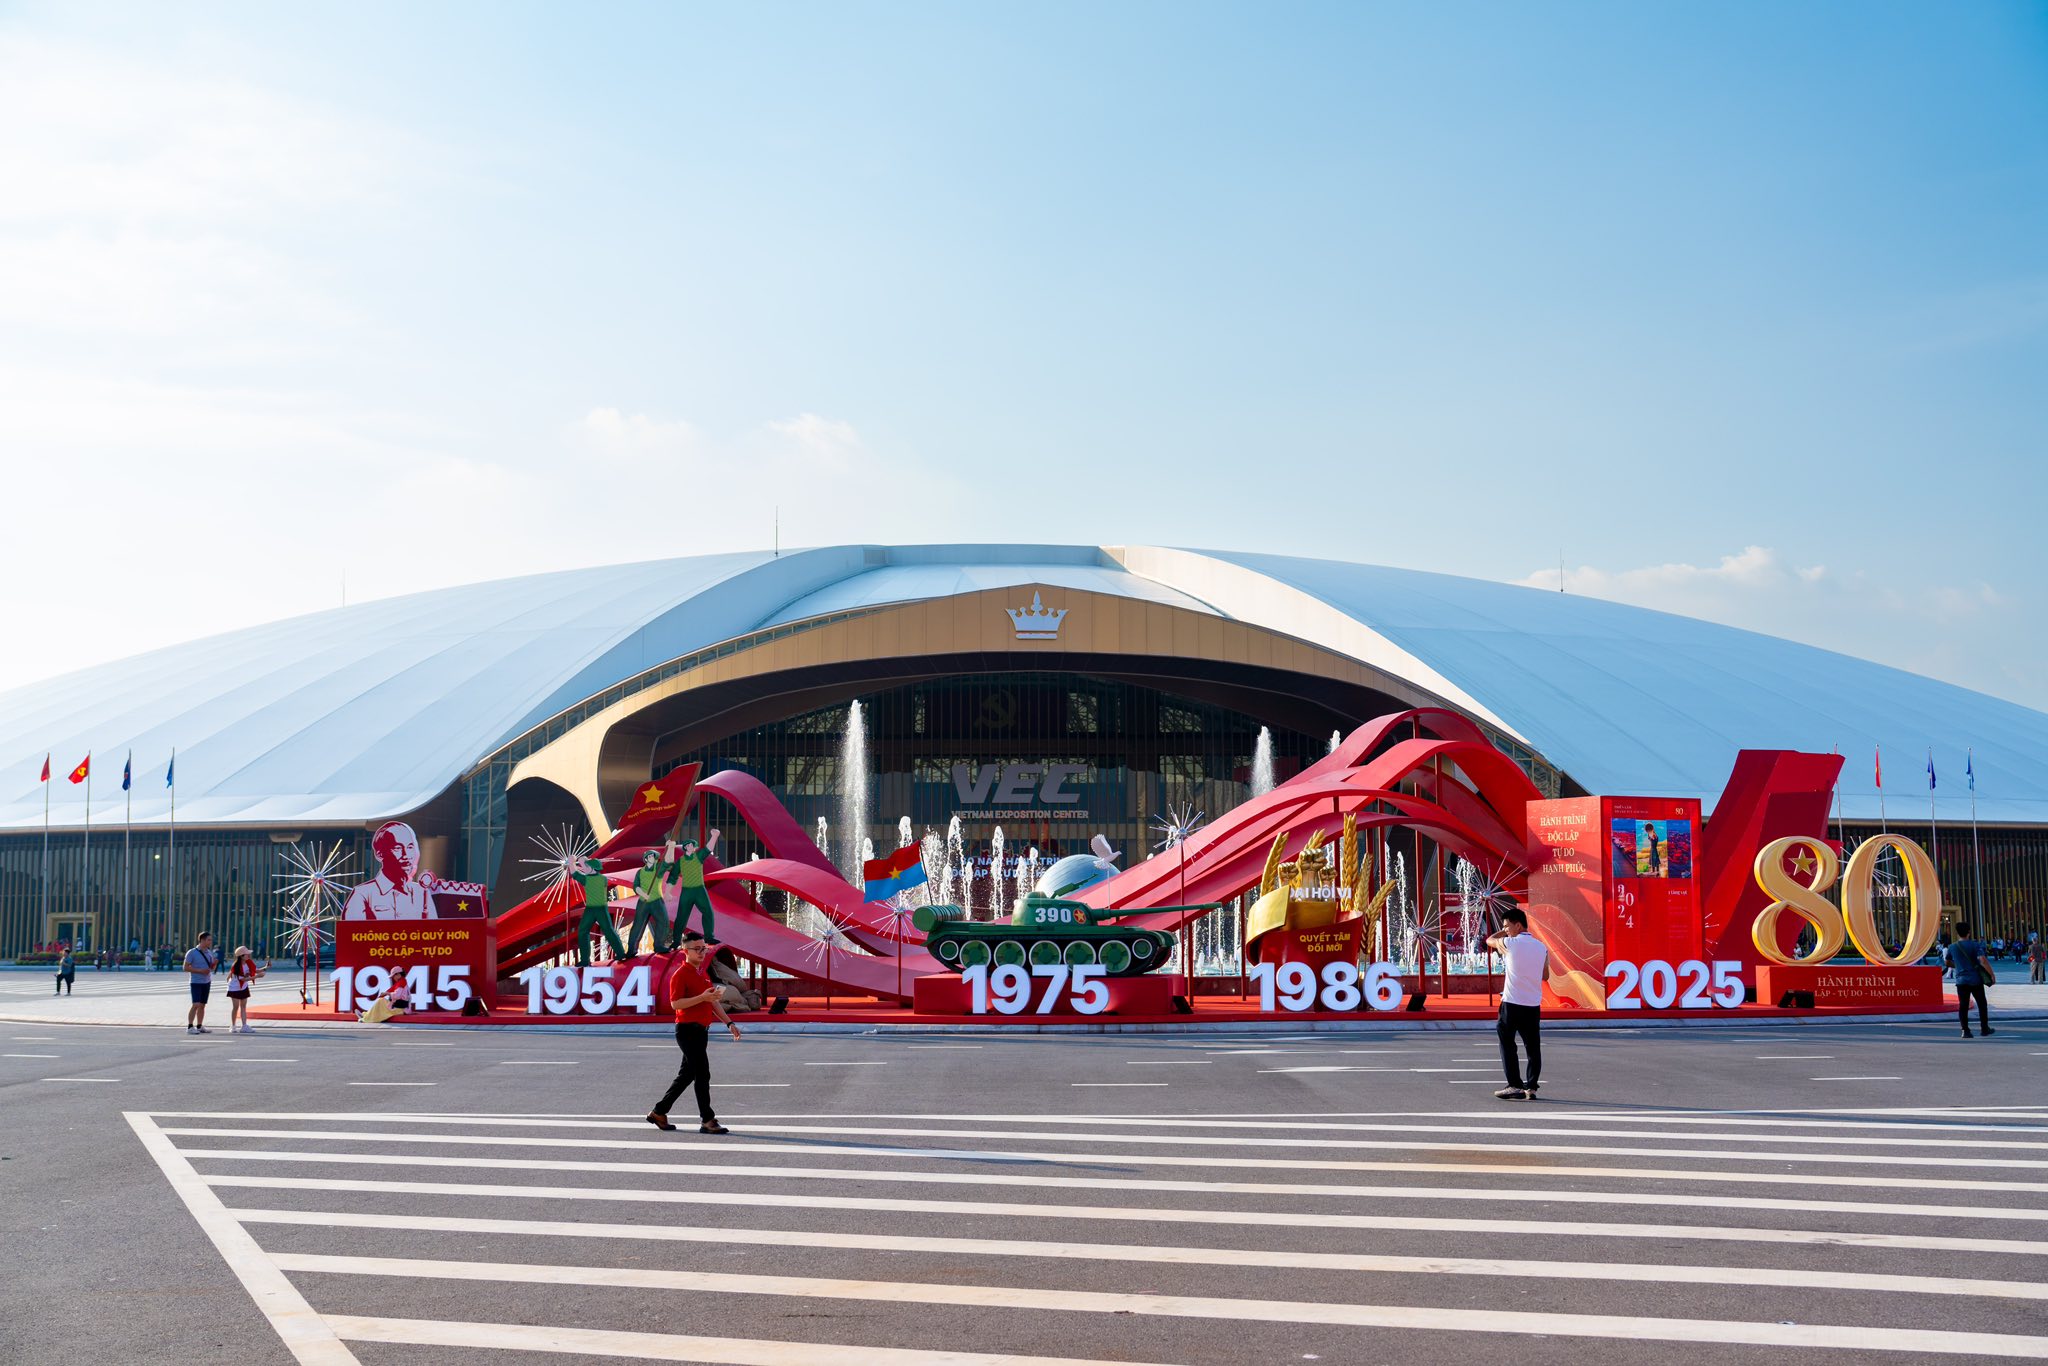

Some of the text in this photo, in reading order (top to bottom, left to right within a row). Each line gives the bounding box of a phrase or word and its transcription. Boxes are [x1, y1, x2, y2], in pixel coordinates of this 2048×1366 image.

[952, 763, 1088, 804] VEC
[951, 810, 1089, 819] VIETNAM EXPOSITION CENTER
[1540, 813, 1587, 826] HÀNH TRÌNH
[1547, 830, 1564, 844] ĐỘC
[1552, 846, 1575, 859] TỰ DO
[1542, 864, 1564, 875] HẠNH
[1312, 884, 1335, 902] HỘI
[1336, 887, 1352, 899] VI
[1751, 833, 1942, 966] 80
[1035, 907, 1072, 923] 390
[352, 929, 470, 942] KHÔNG CÓ GÌ QUÝ HƠN
[1299, 931, 1331, 942] QUYẾT
[369, 945, 393, 959] ĐỘC
[437, 946, 453, 956] DO
[1326, 942, 1343, 952] MỚI
[1250, 961, 1403, 1012] 1986
[1604, 960, 1745, 1009] 2025
[1817, 974, 1896, 987] HÀNH TRÌNH
[329, 965, 473, 1013] 1945
[519, 966, 656, 1015] 1954
[962, 963, 1110, 1015] 1975
[1838, 989, 1849, 999] TỰ
[1850, 989, 1863, 997] DO
[1870, 989, 1895, 998] HẠNH
[1896, 988, 1920, 997] PHÚC
